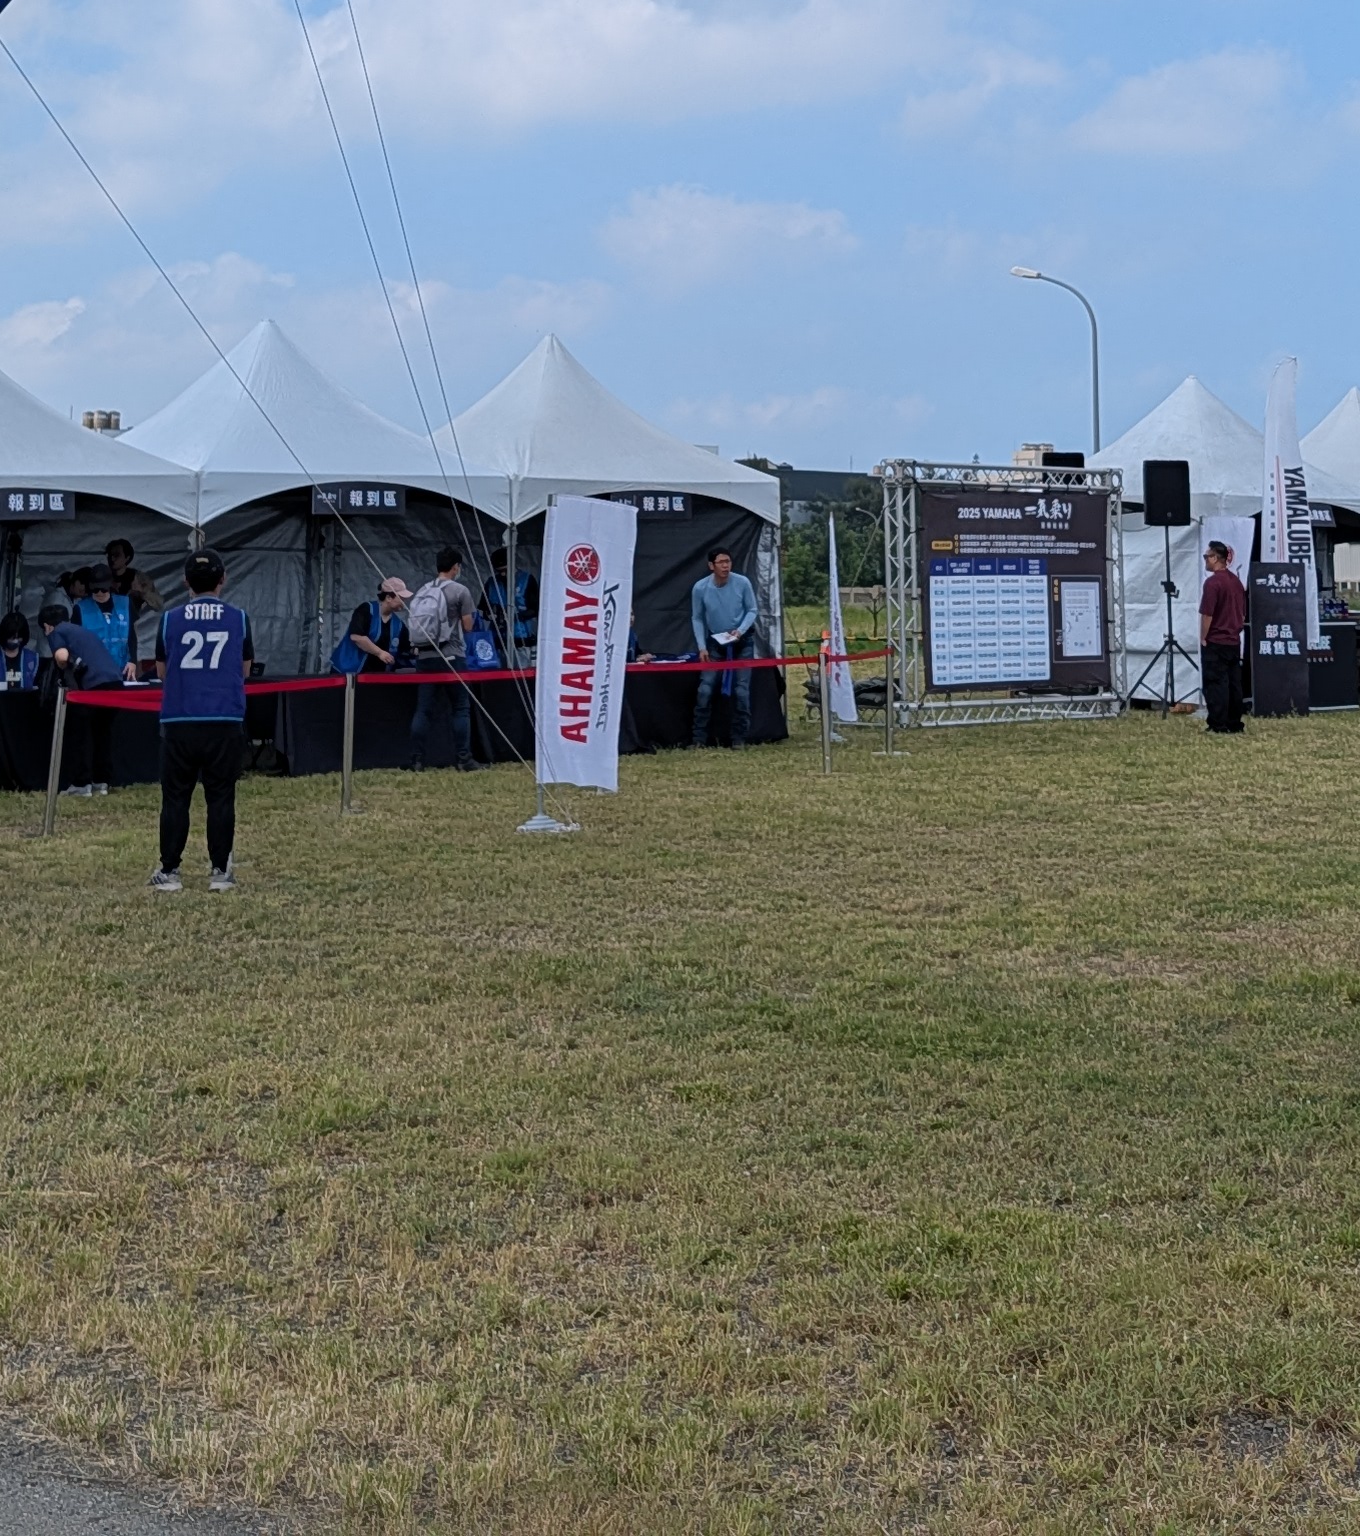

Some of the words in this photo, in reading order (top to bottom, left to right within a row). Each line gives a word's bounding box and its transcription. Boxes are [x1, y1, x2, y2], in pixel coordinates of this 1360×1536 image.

[8, 493, 65, 512] 報到區
[349, 489, 397, 507] 報到區
[643, 496, 685, 512] 報到區
[957, 507, 981, 519] 2025
[982, 507, 1022, 520] YAMAHA
[1284, 466, 1312, 564] YAMALUBE
[184, 602, 224, 620] STAFF
[1265, 623, 1293, 639] 部品
[180, 630, 229, 669] 27
